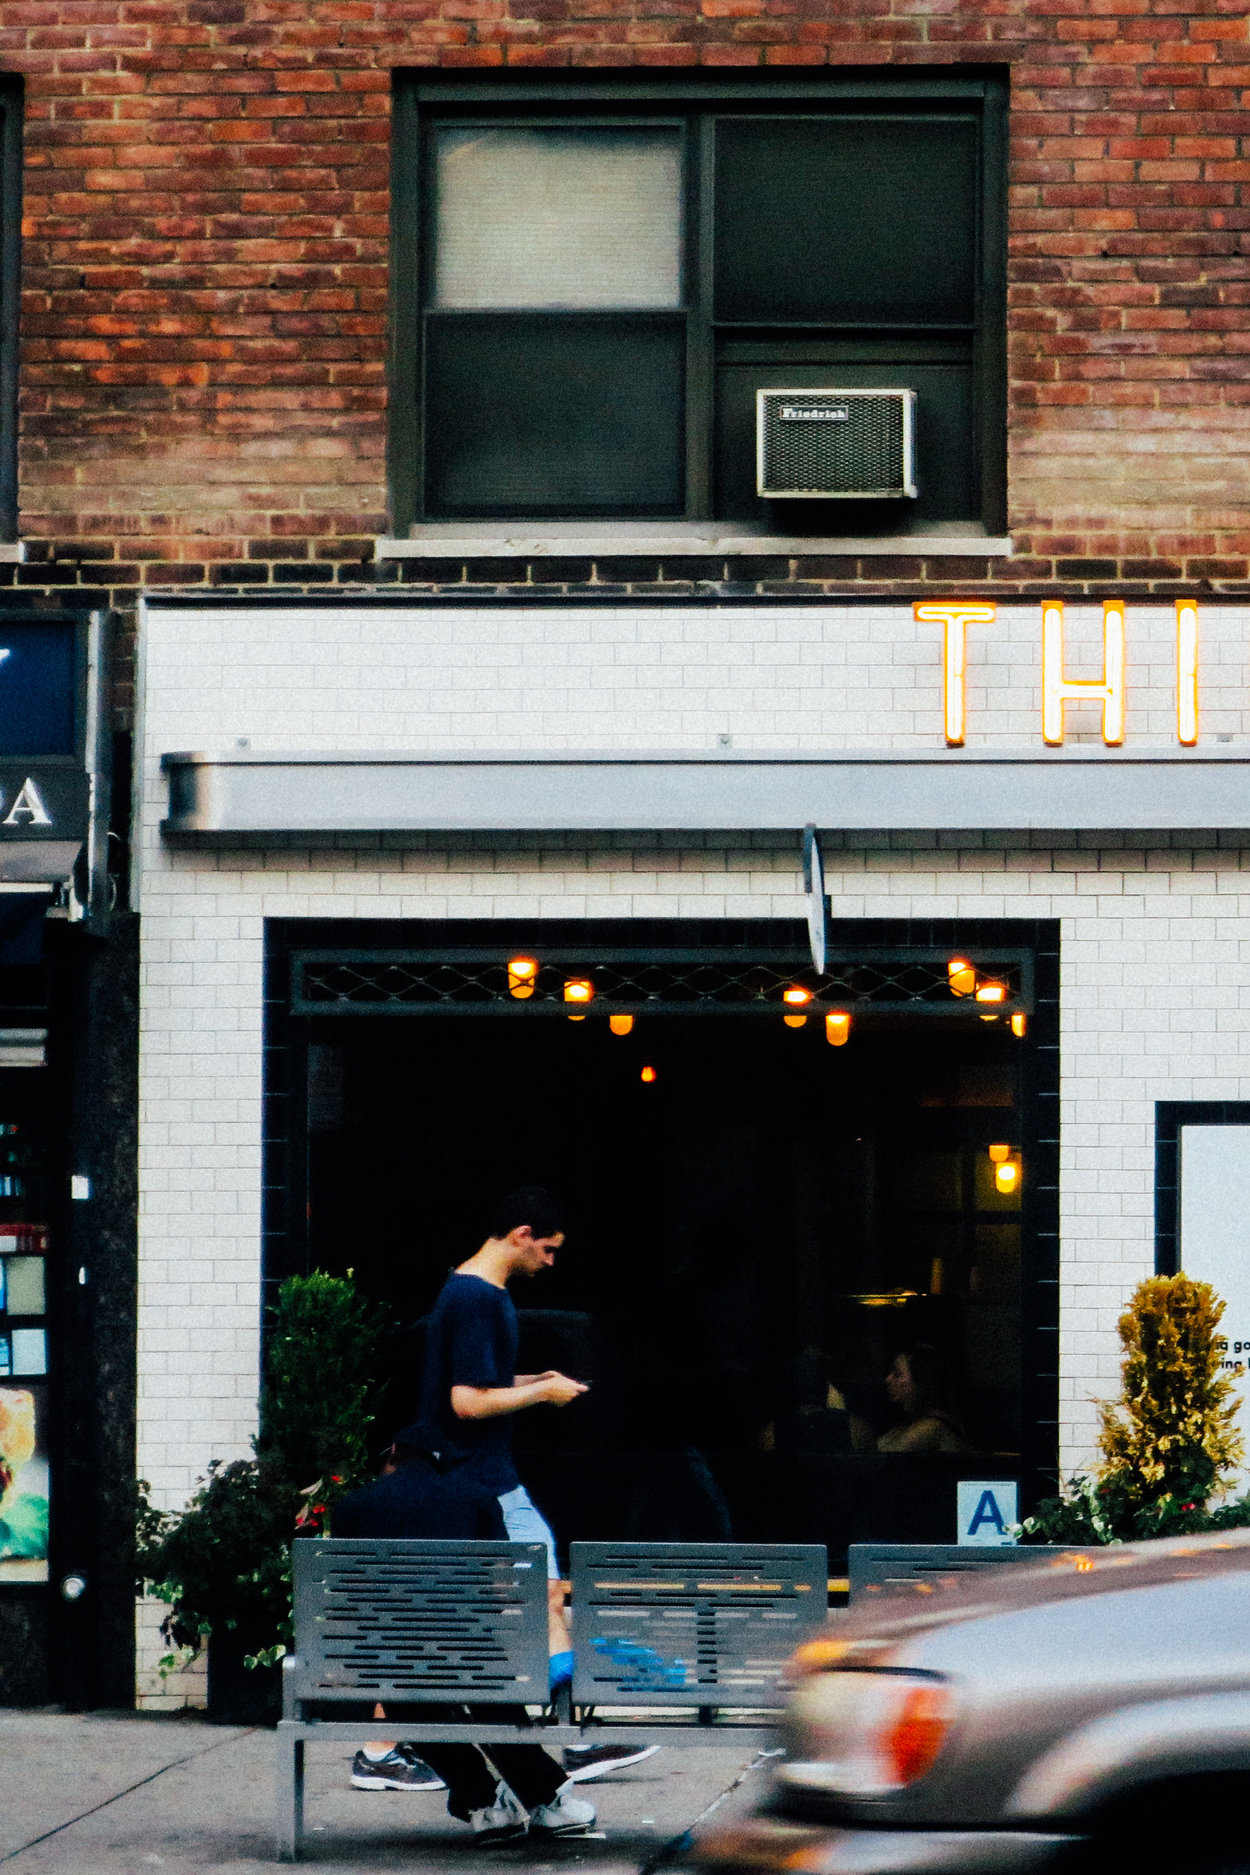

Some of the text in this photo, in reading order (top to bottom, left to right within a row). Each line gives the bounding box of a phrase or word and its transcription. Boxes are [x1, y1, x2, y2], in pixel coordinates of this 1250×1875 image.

[782, 408, 845, 418] Friedrich
[0, 777, 52, 823] A
[967, 1490, 1008, 1535] A
